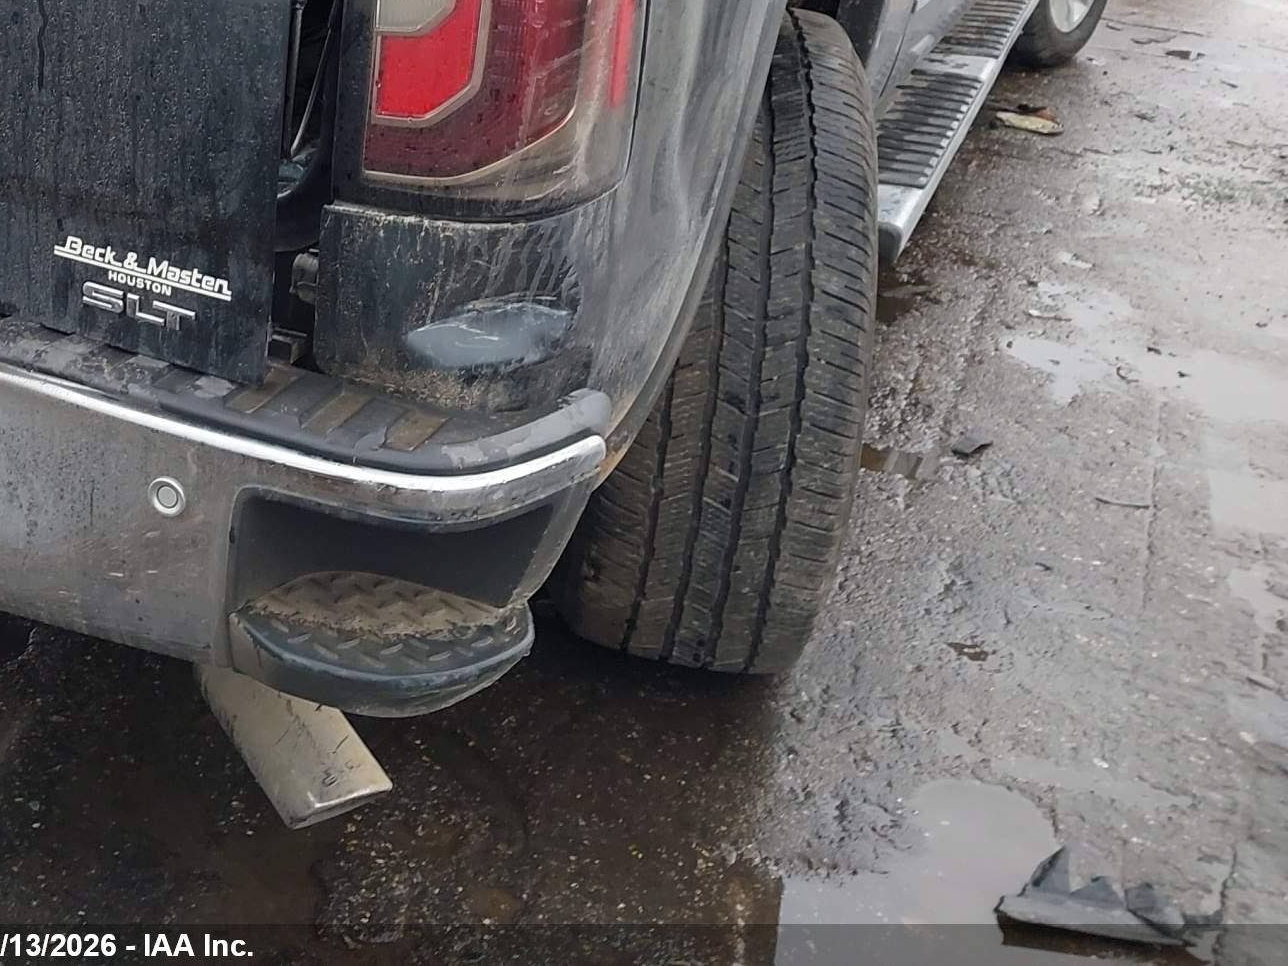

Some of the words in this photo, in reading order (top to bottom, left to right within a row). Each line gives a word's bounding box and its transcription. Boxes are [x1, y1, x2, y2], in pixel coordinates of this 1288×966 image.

[62, 235, 123, 266] Beck
[124, 251, 143, 271] &
[108, 270, 172, 296] HOUSTON
[82, 281, 197, 331] SLT
